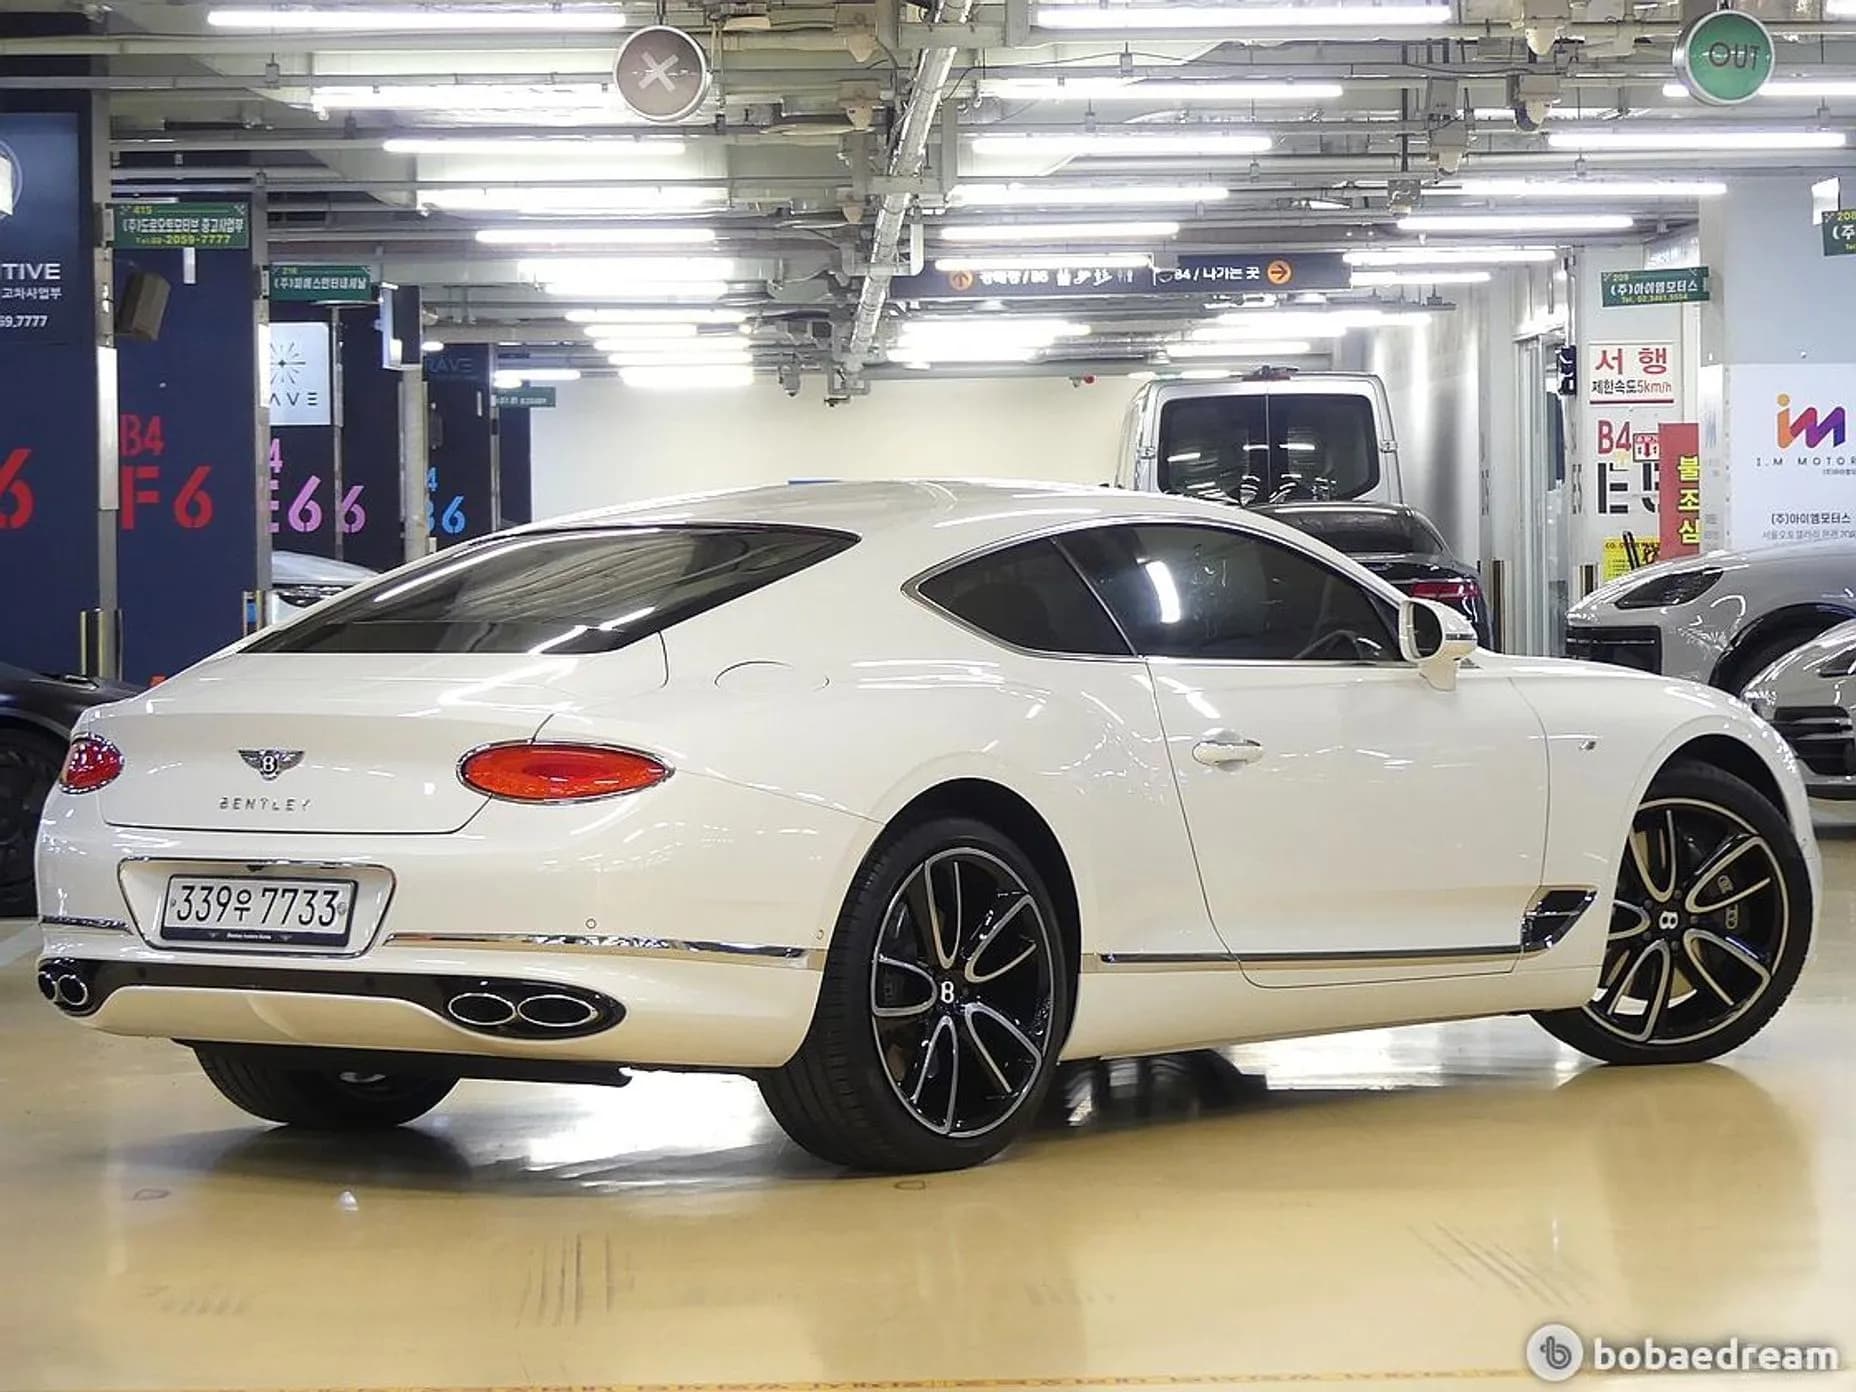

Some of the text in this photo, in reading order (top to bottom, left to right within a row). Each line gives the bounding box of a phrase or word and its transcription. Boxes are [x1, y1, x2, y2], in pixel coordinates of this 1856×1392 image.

[1709, 42, 1760, 70] OUT
[1, 263, 61, 280] TIVE
[1202, 267, 1242, 280] 나가는
[1610, 280, 1698, 297] (주)아이엠모터스
[120, 414, 164, 456] B4
[1598, 420, 1632, 455] B4
[1771, 512, 1852, 525] (주)아이엠모터스
[219, 797, 312, 812] BENTLEY
[177, 885, 340, 926] 339우 7733
